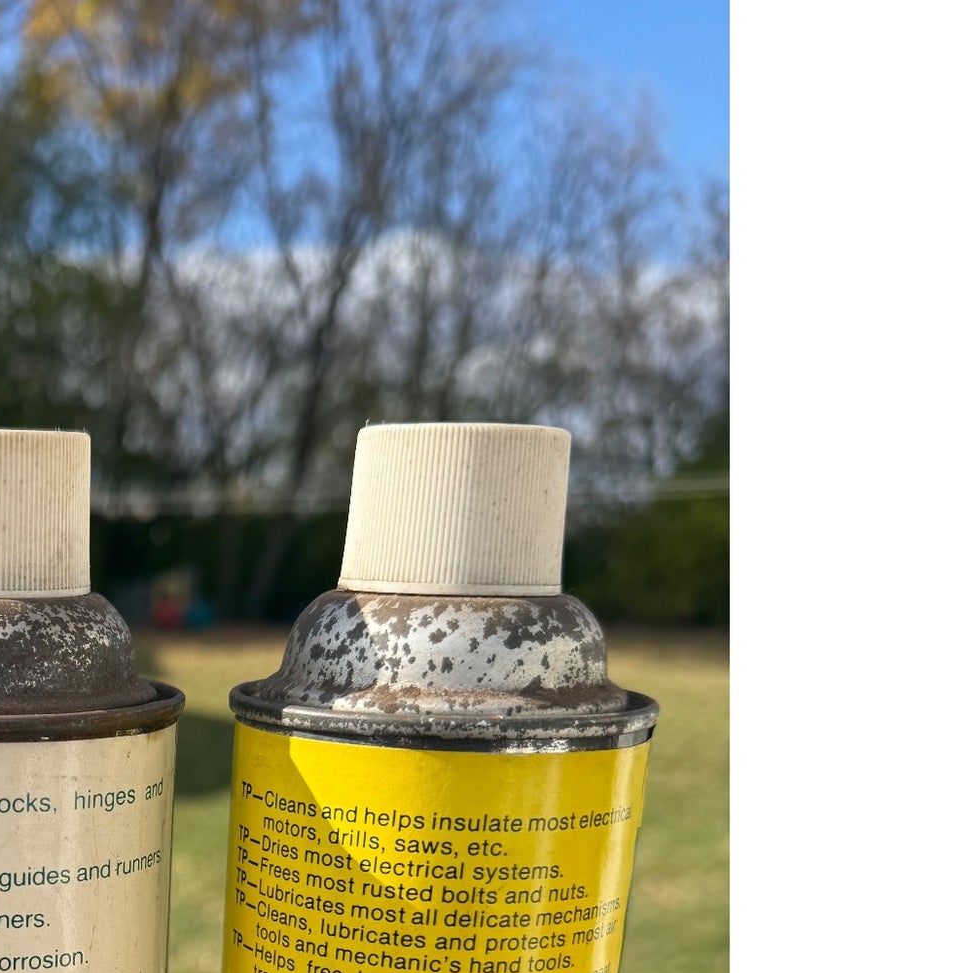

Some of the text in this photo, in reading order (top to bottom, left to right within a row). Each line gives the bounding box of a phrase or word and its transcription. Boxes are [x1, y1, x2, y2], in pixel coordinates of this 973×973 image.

[74, 788, 136, 811] hinges
[145, 777, 163, 800] and
[241, 780, 632, 832] TP—Cleans and helps insulate most electrical
[239, 824, 563, 885] TP—Dries most electrical systems.
[263, 816, 507, 858] motors, drills, saws, etc.
[77, 859, 111, 882] and
